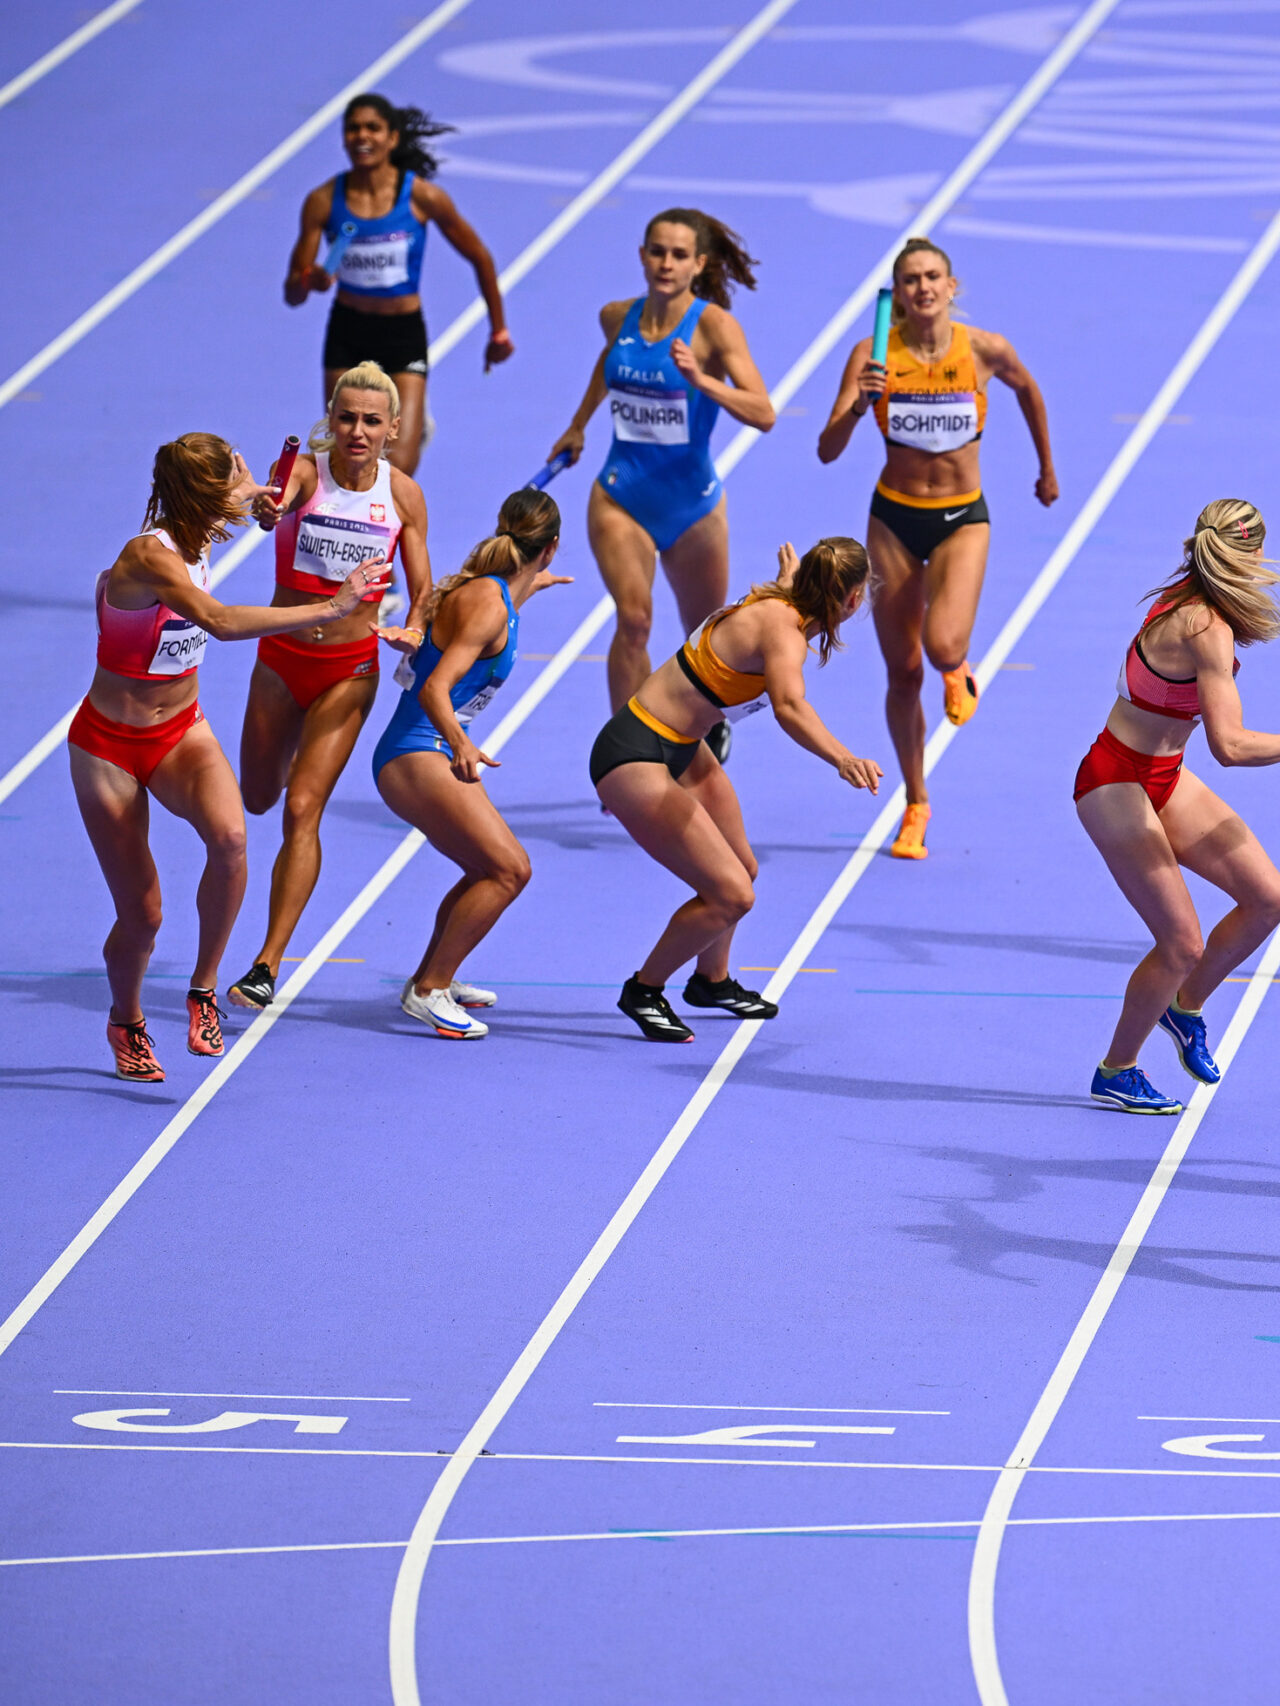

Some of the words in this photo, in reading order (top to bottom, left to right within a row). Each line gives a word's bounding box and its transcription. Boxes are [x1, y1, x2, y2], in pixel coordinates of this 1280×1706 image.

[618, 365, 666, 384] ITALIA
[611, 400, 685, 424] POLINARI
[890, 414, 972, 432] SCHMIDT
[324, 519, 347, 529] PARIS
[72, 1408, 349, 1434] 5
[615, 1425, 896, 1448] 4
